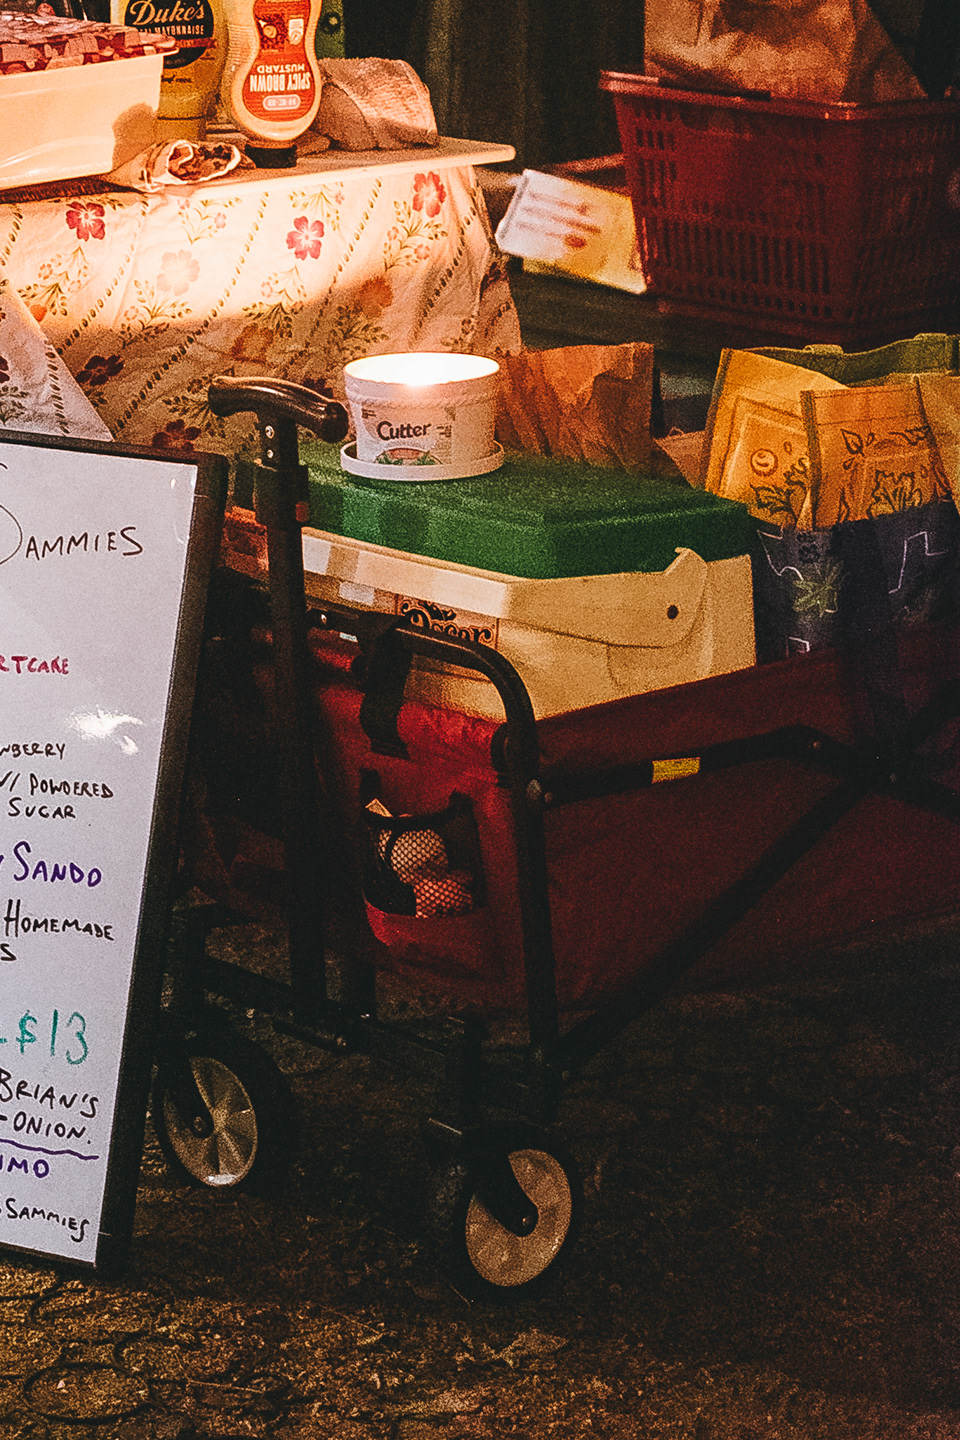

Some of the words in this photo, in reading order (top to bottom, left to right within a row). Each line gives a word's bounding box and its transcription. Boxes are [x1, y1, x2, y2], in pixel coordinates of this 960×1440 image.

[130, 0, 205, 25] Duke's
[154, 25, 204, 36] MAYONNAISE
[257, 64, 305, 74] MUSTARD
[250, 74, 285, 92] BROWN
[287, 72, 311, 91] SPICY
[377, 421, 431, 441] Cutter
[29, 773, 115, 799] POWDERED
[7, 797, 77, 819] SUGAR
[13, 840, 103, 888] SANDO
[3, 898, 116, 942] HOMEMADE
[15, 1009, 90, 1065] $13
[13, 1110, 91, 1145] ONION.
